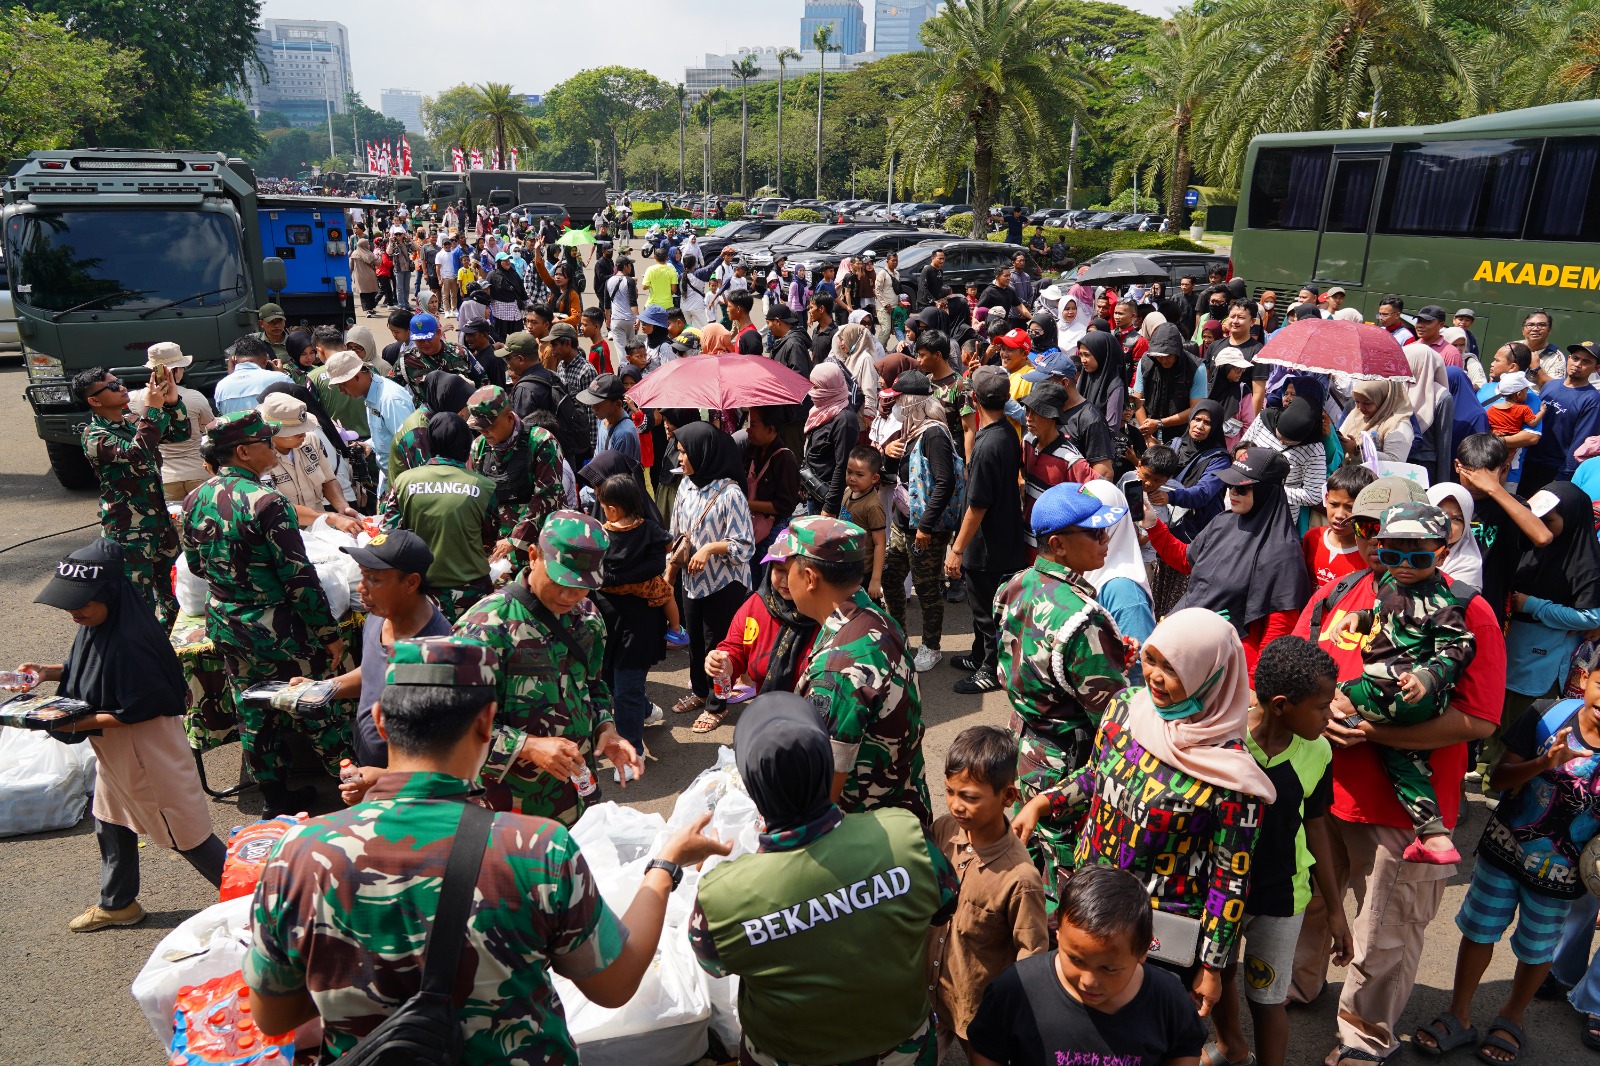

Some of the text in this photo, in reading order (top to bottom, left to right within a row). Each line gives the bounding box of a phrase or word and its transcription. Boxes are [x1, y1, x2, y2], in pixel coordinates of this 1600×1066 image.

[1472, 260, 1600, 290] AKADEM
[408, 481, 481, 498] BEKANGAD
[1091, 507, 1124, 527] PRO
[741, 866, 911, 946] BEKANGAD
